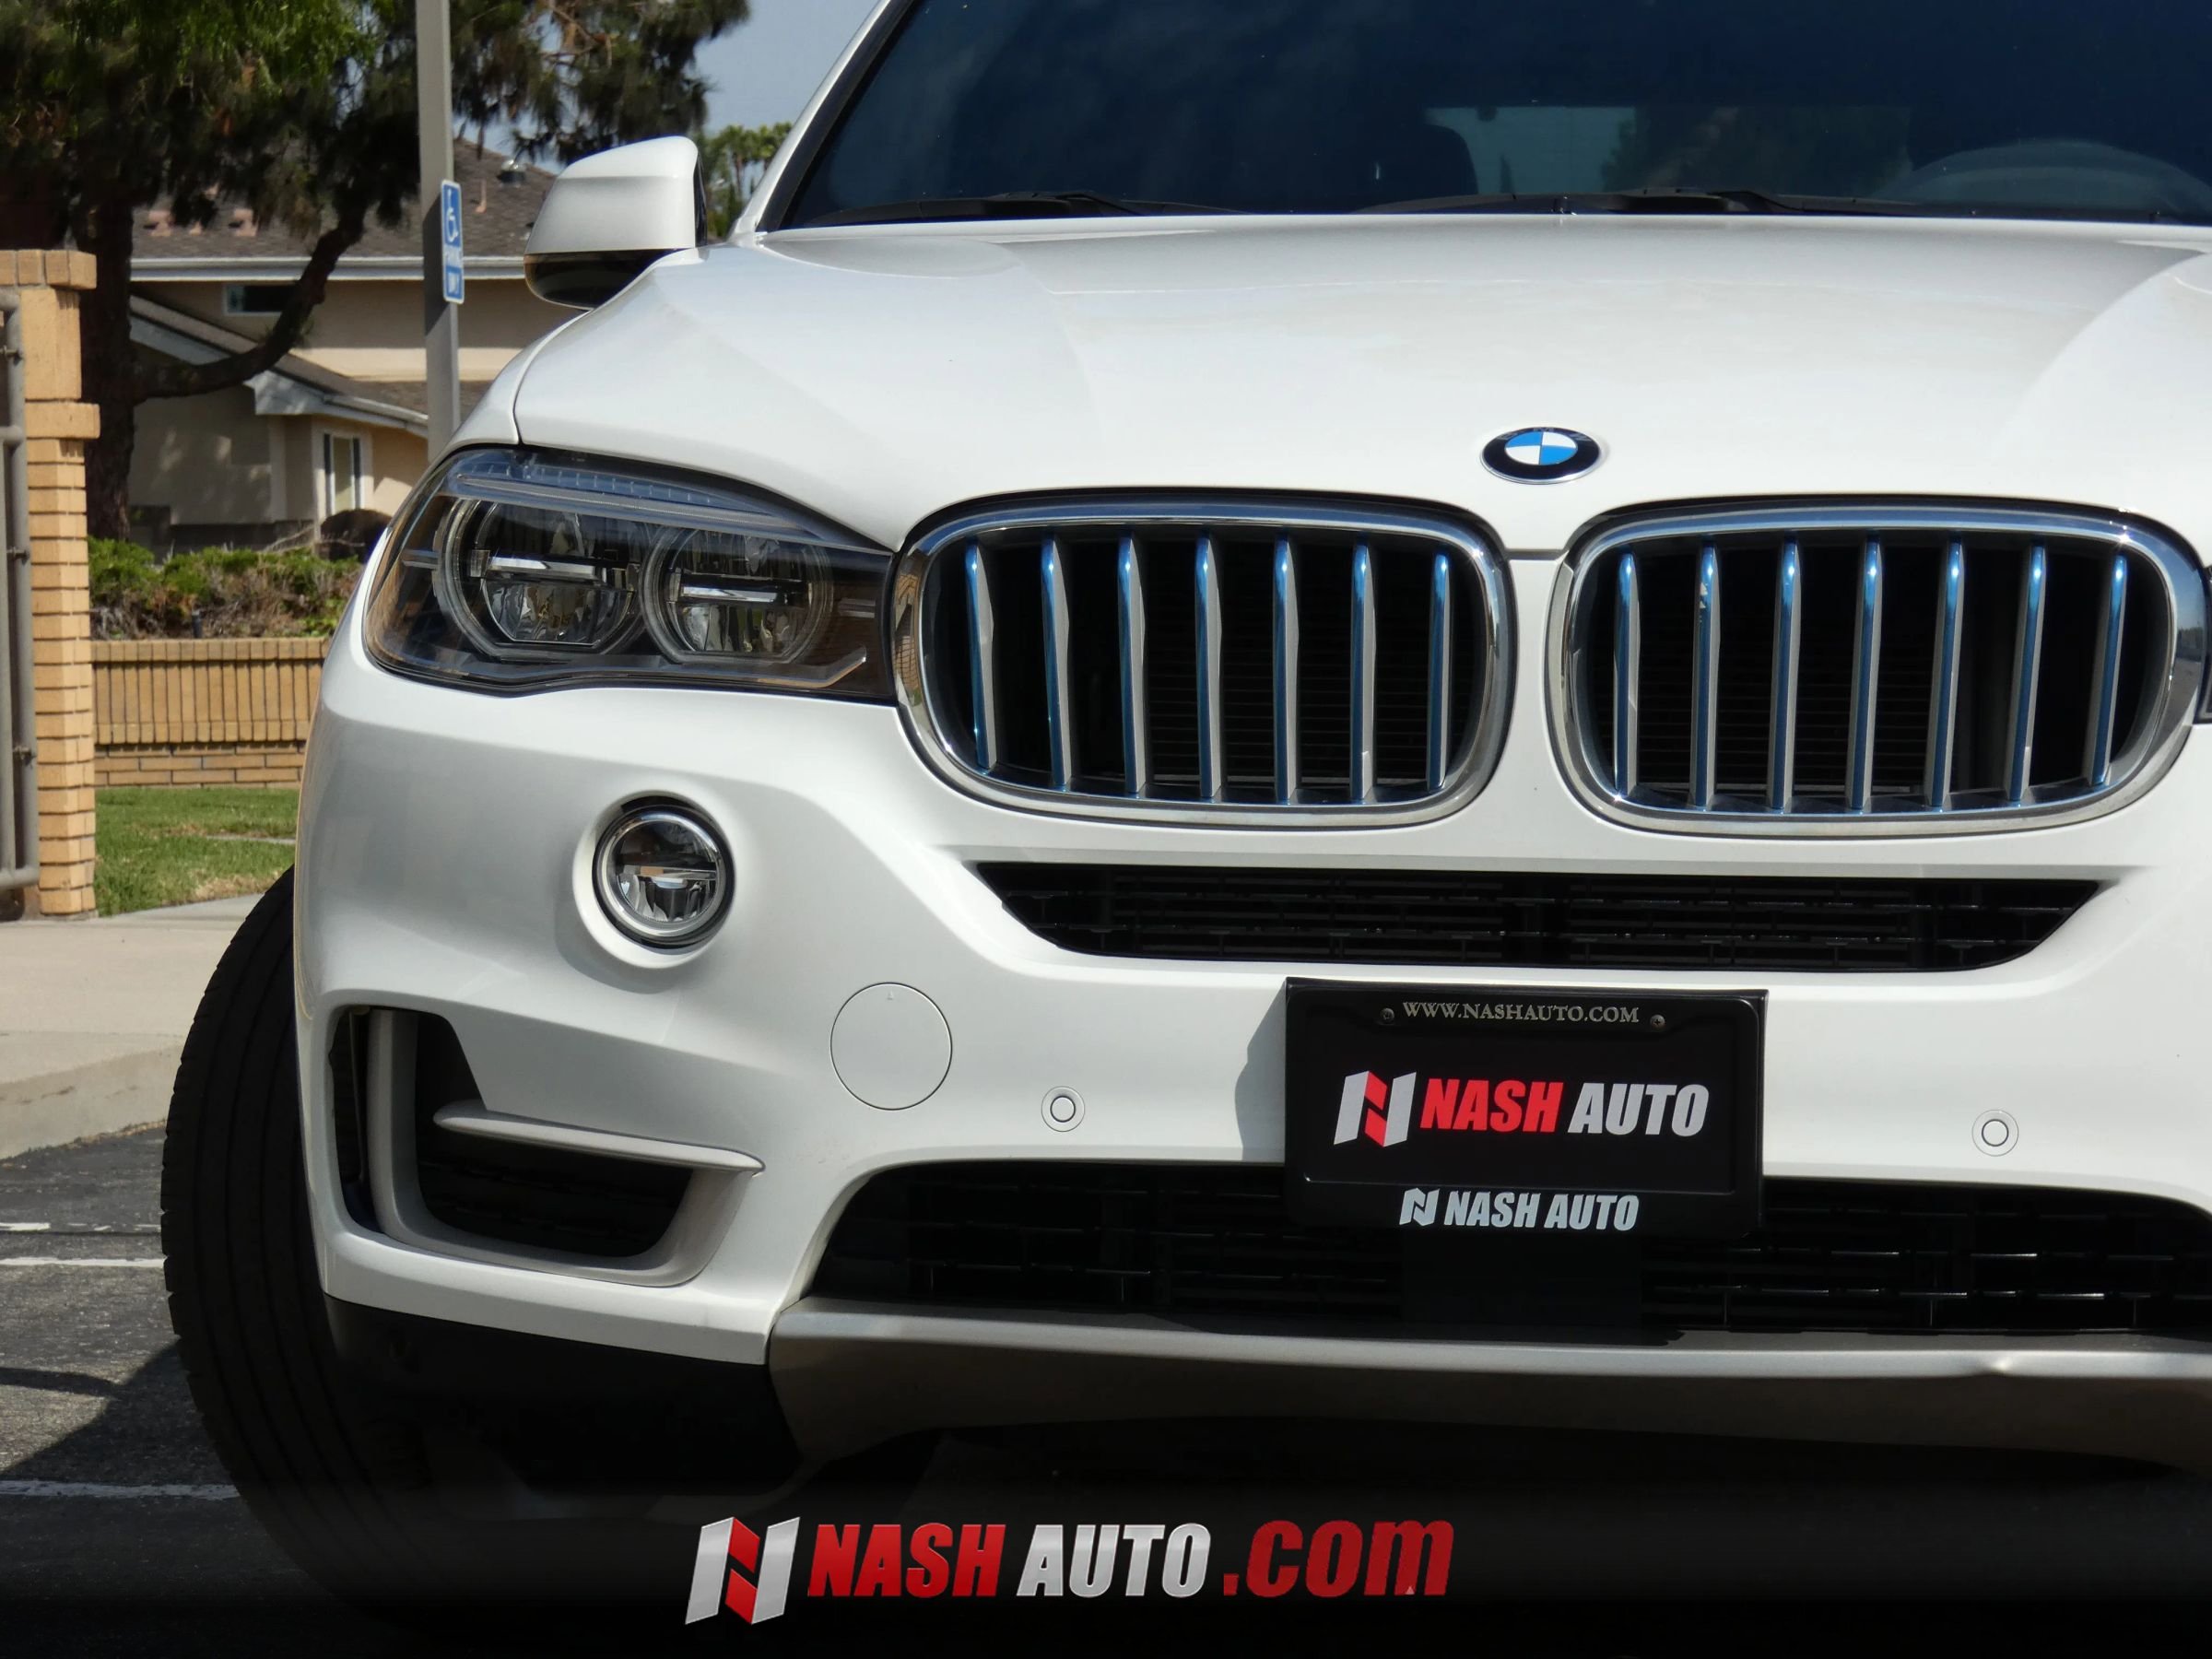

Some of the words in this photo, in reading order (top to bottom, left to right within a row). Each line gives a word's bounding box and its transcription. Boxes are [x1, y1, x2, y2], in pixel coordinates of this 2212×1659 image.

[1403, 1001, 1640, 1023] WWW.NASHAUTO.COM
[1419, 1077, 1564, 1134] NASH
[1567, 1082, 1710, 1137] AUTO
[1443, 1190, 1542, 1229] NASH
[1543, 1194, 1640, 1231] AUTO
